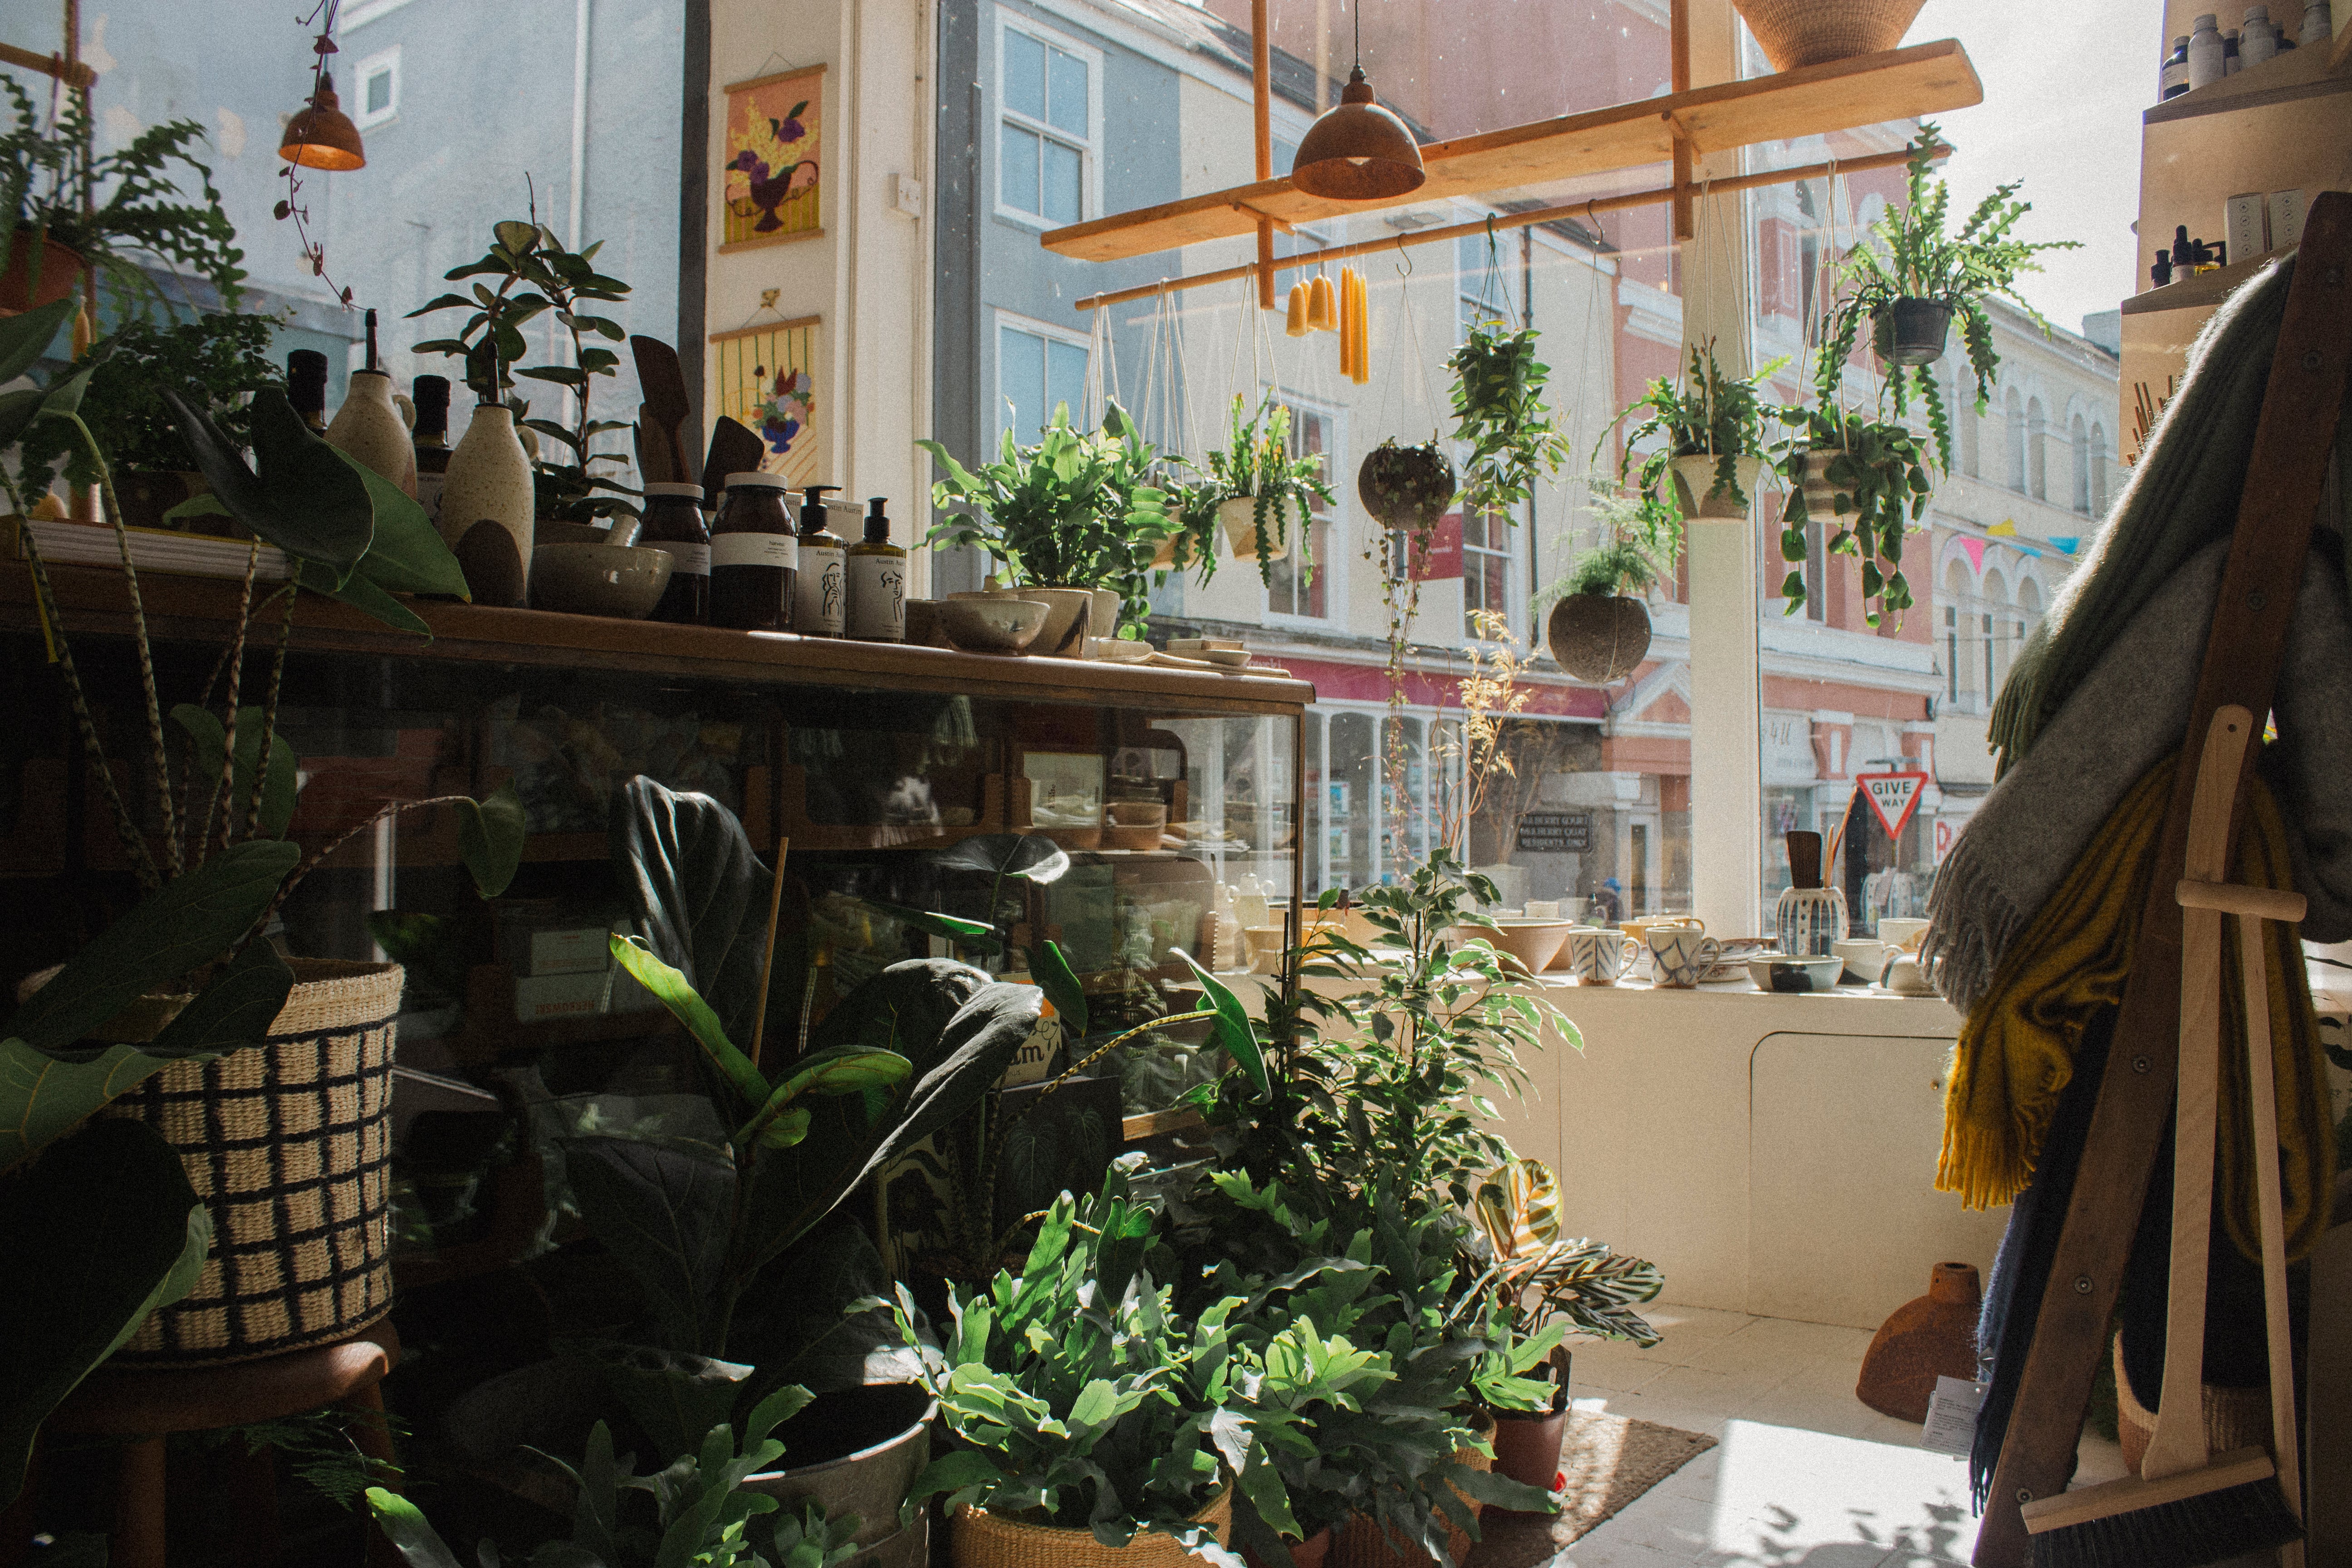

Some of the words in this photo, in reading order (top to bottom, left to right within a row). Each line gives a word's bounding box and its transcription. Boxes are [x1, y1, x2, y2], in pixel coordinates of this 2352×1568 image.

[843, 505, 862, 515] Austin
[1872, 781, 1912, 795] GIVE
[1881, 798, 1906, 807] WAY
